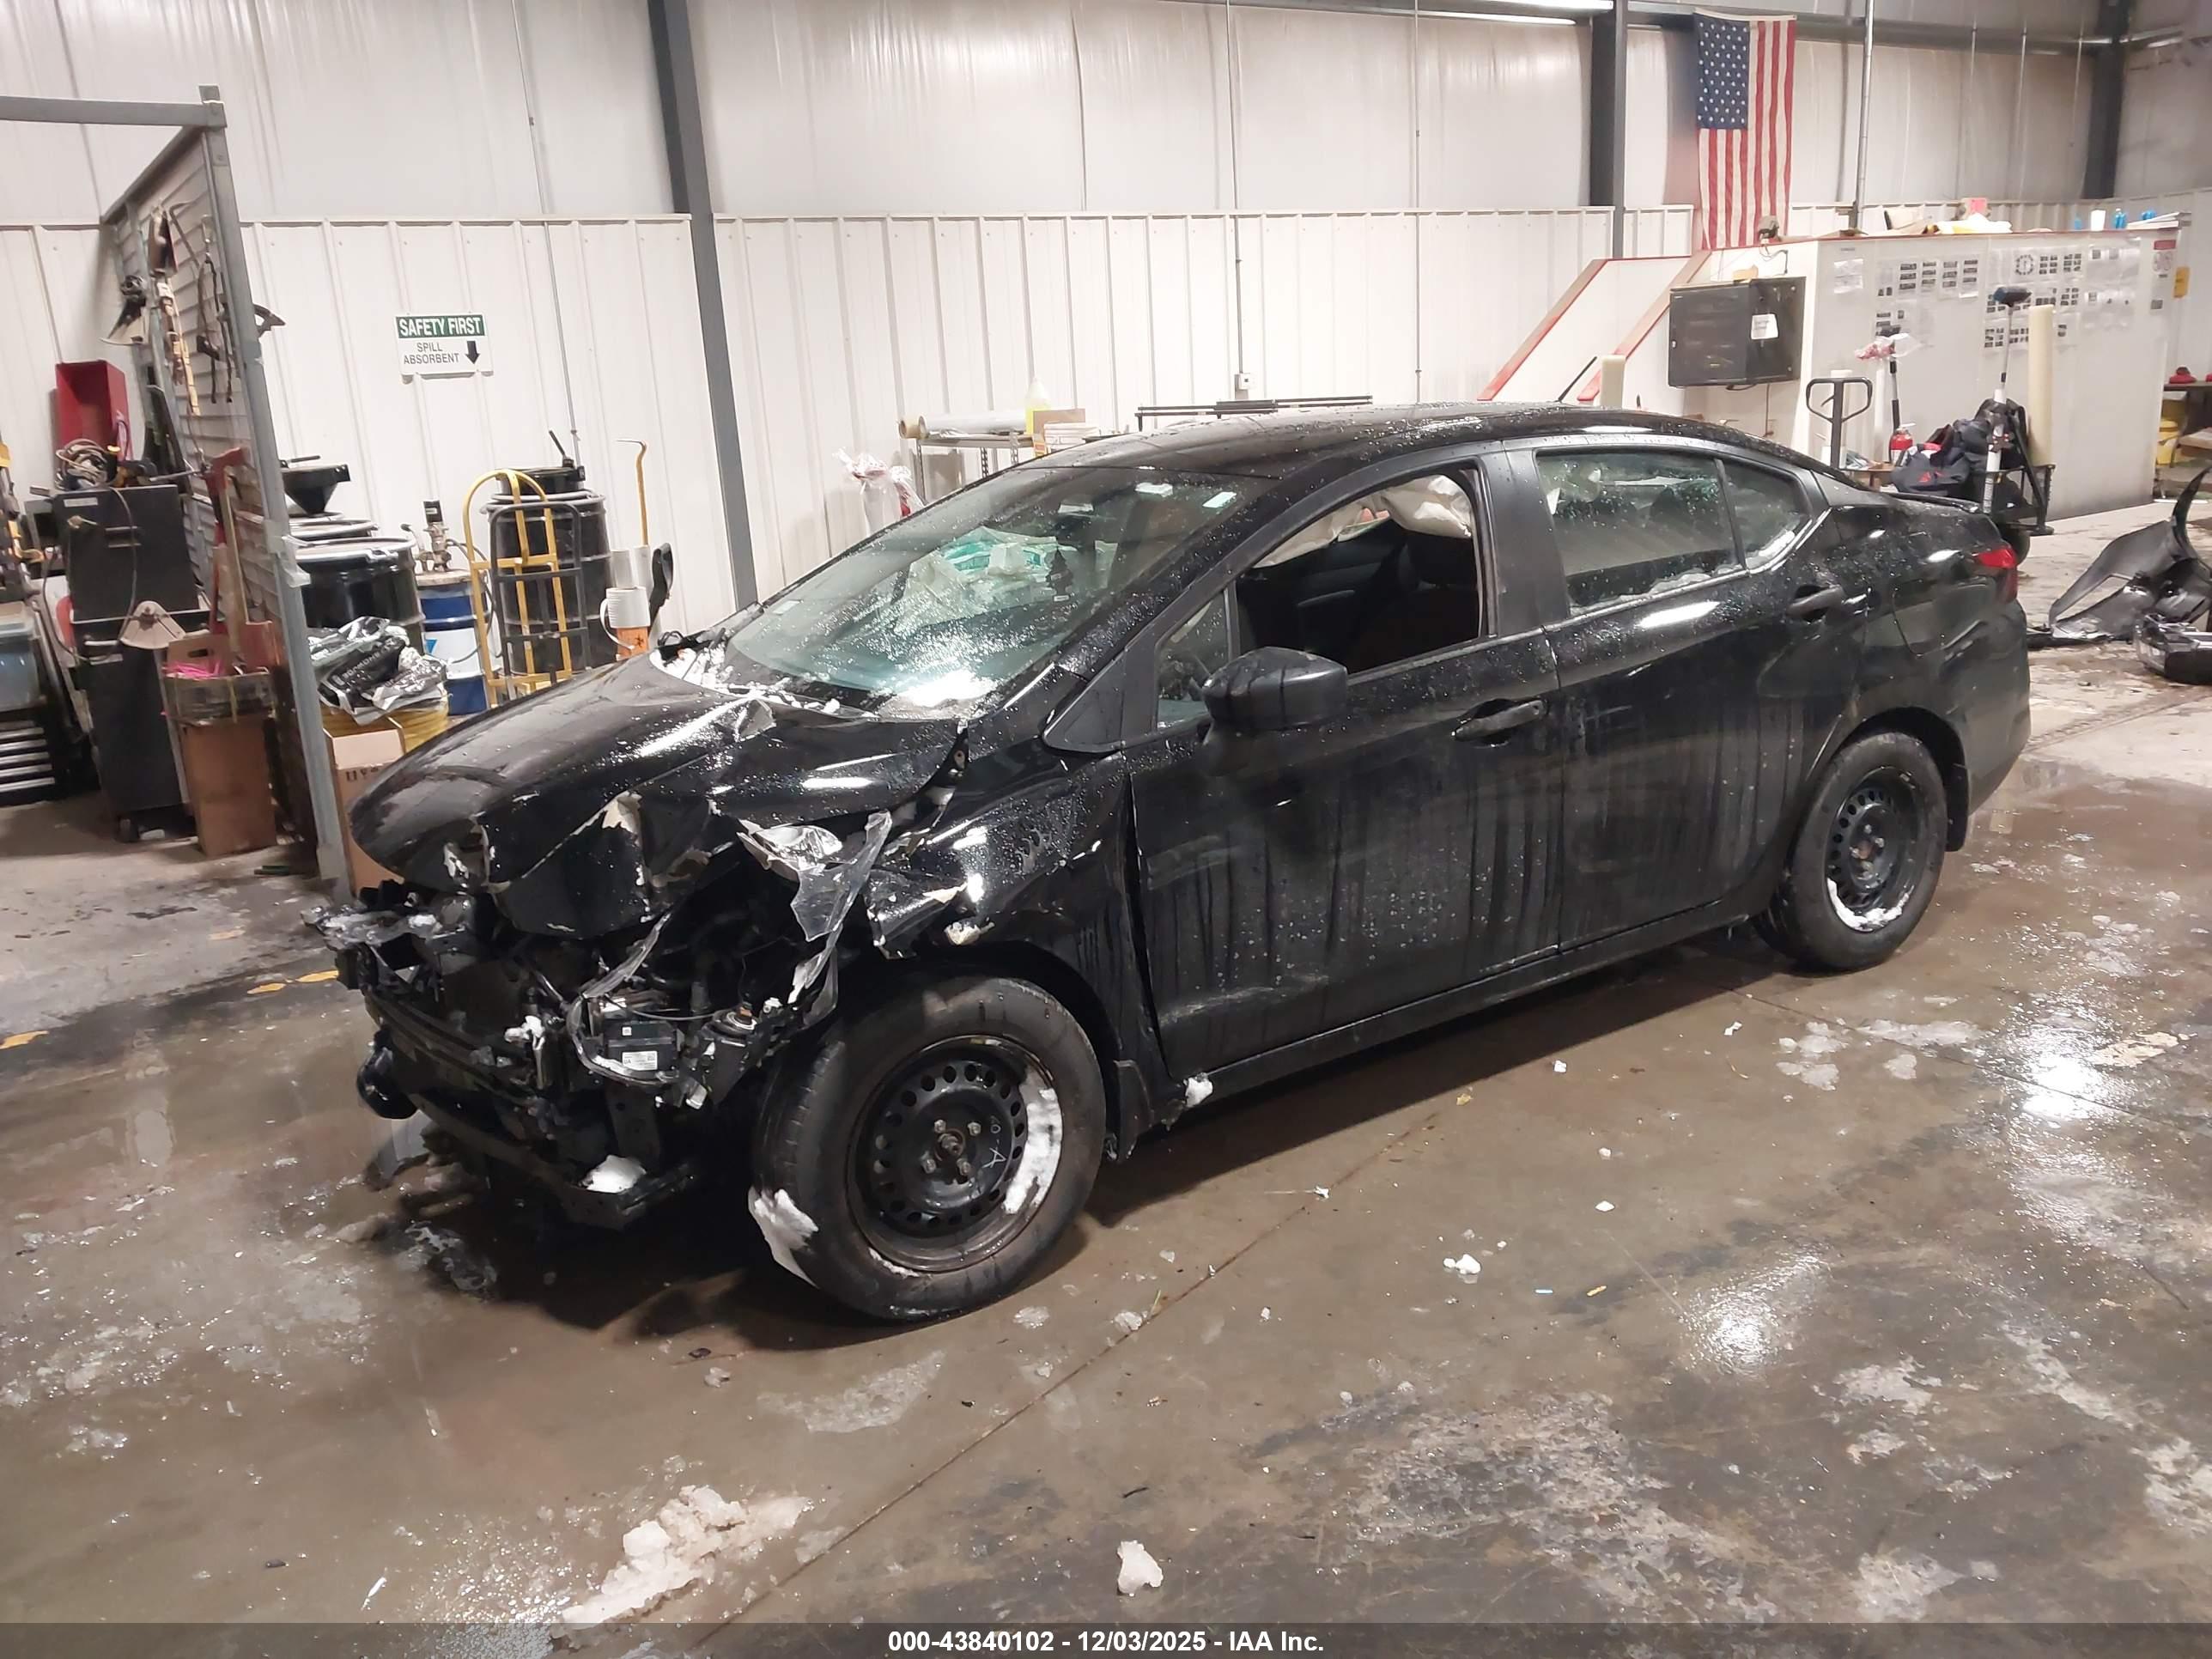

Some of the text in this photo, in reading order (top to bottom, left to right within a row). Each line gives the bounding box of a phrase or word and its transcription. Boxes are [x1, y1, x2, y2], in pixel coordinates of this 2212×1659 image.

[399, 318, 482, 336] SAFETY FIRST
[417, 343, 442, 352] SPILL
[404, 353, 459, 364] ABSORBENT
